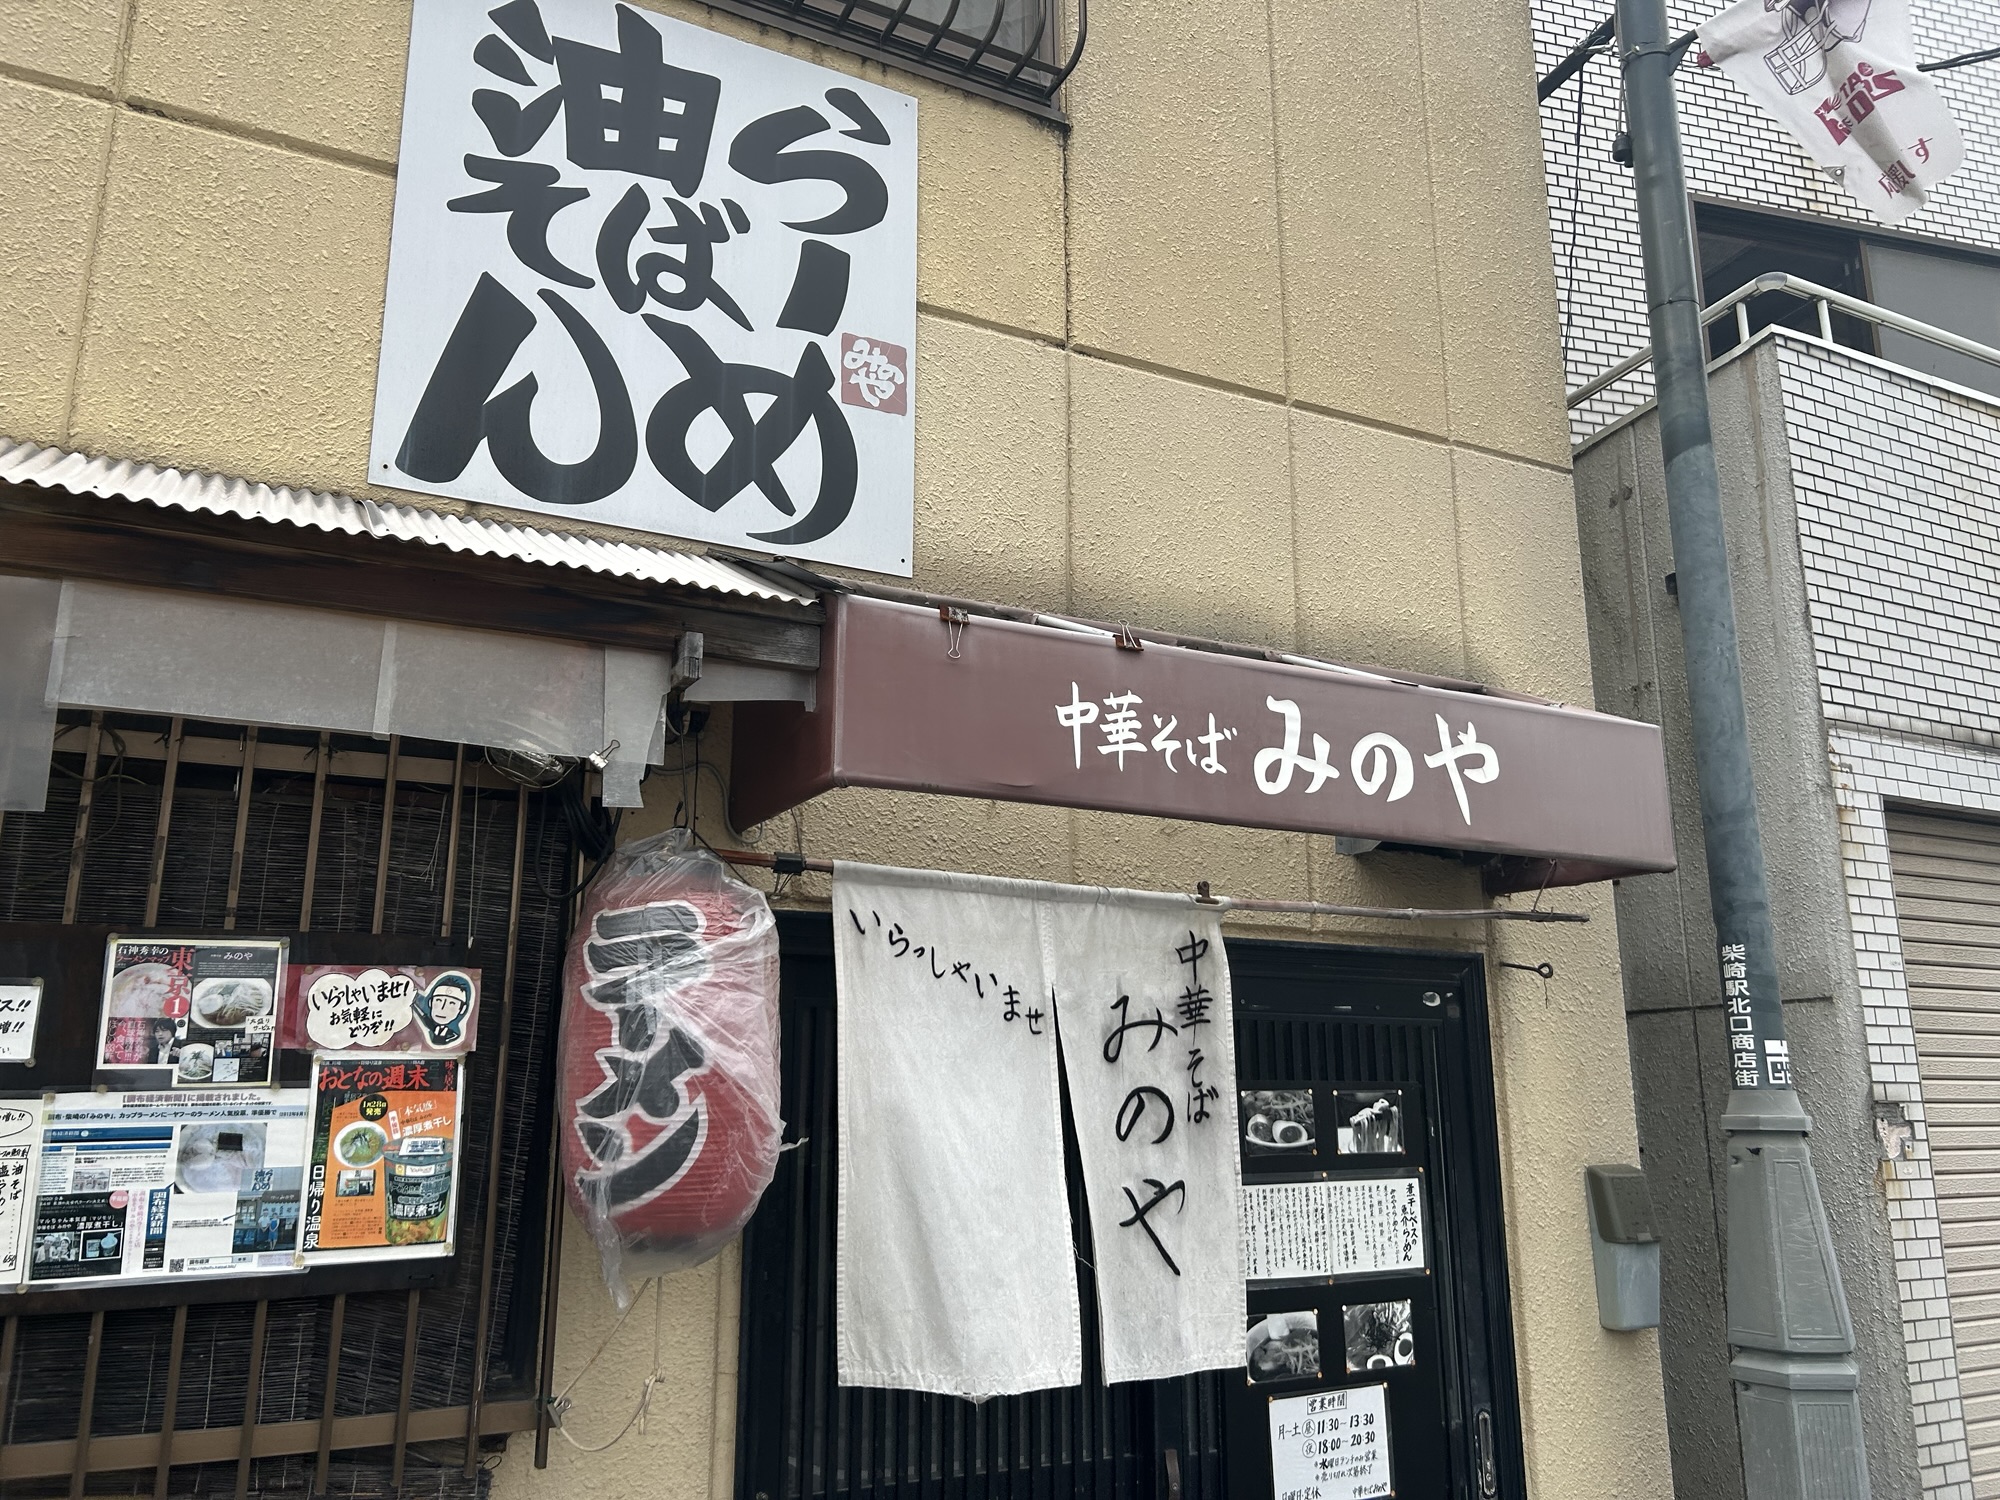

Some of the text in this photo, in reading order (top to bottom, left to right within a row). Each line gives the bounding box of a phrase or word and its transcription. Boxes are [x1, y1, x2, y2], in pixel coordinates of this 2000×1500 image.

[446, 0, 752, 333] 油そば
[394, 87, 891, 546] らーめん
[843, 338, 905, 408] みのや
[1054, 680, 1501, 827] 中華そば みのや
[166, 947, 195, 995] 東京
[223, 952, 254, 961] みのや
[849, 908, 1045, 1035] いらっしゃいませ
[329, 1006, 383, 1026] お気軽に
[1175, 929, 1220, 1124] 中華そば
[1721, 943, 1760, 1087] 柴崎駅北口商店街
[319, 1063, 431, 1092] おとなの週末
[402, 1116, 453, 1137] 濃厚煮干し
[1103, 994, 1187, 1277] みのや
[149, 1191, 167, 1235] 調布経済新聞
[303, 1164, 326, 1249] 日帰り温泉
[393, 1201, 446, 1217] 濃厚煮干し
[1400, 1204, 1412, 1262] 魚介らーめん
[1308, 1393, 1346, 1413] 営業時間
